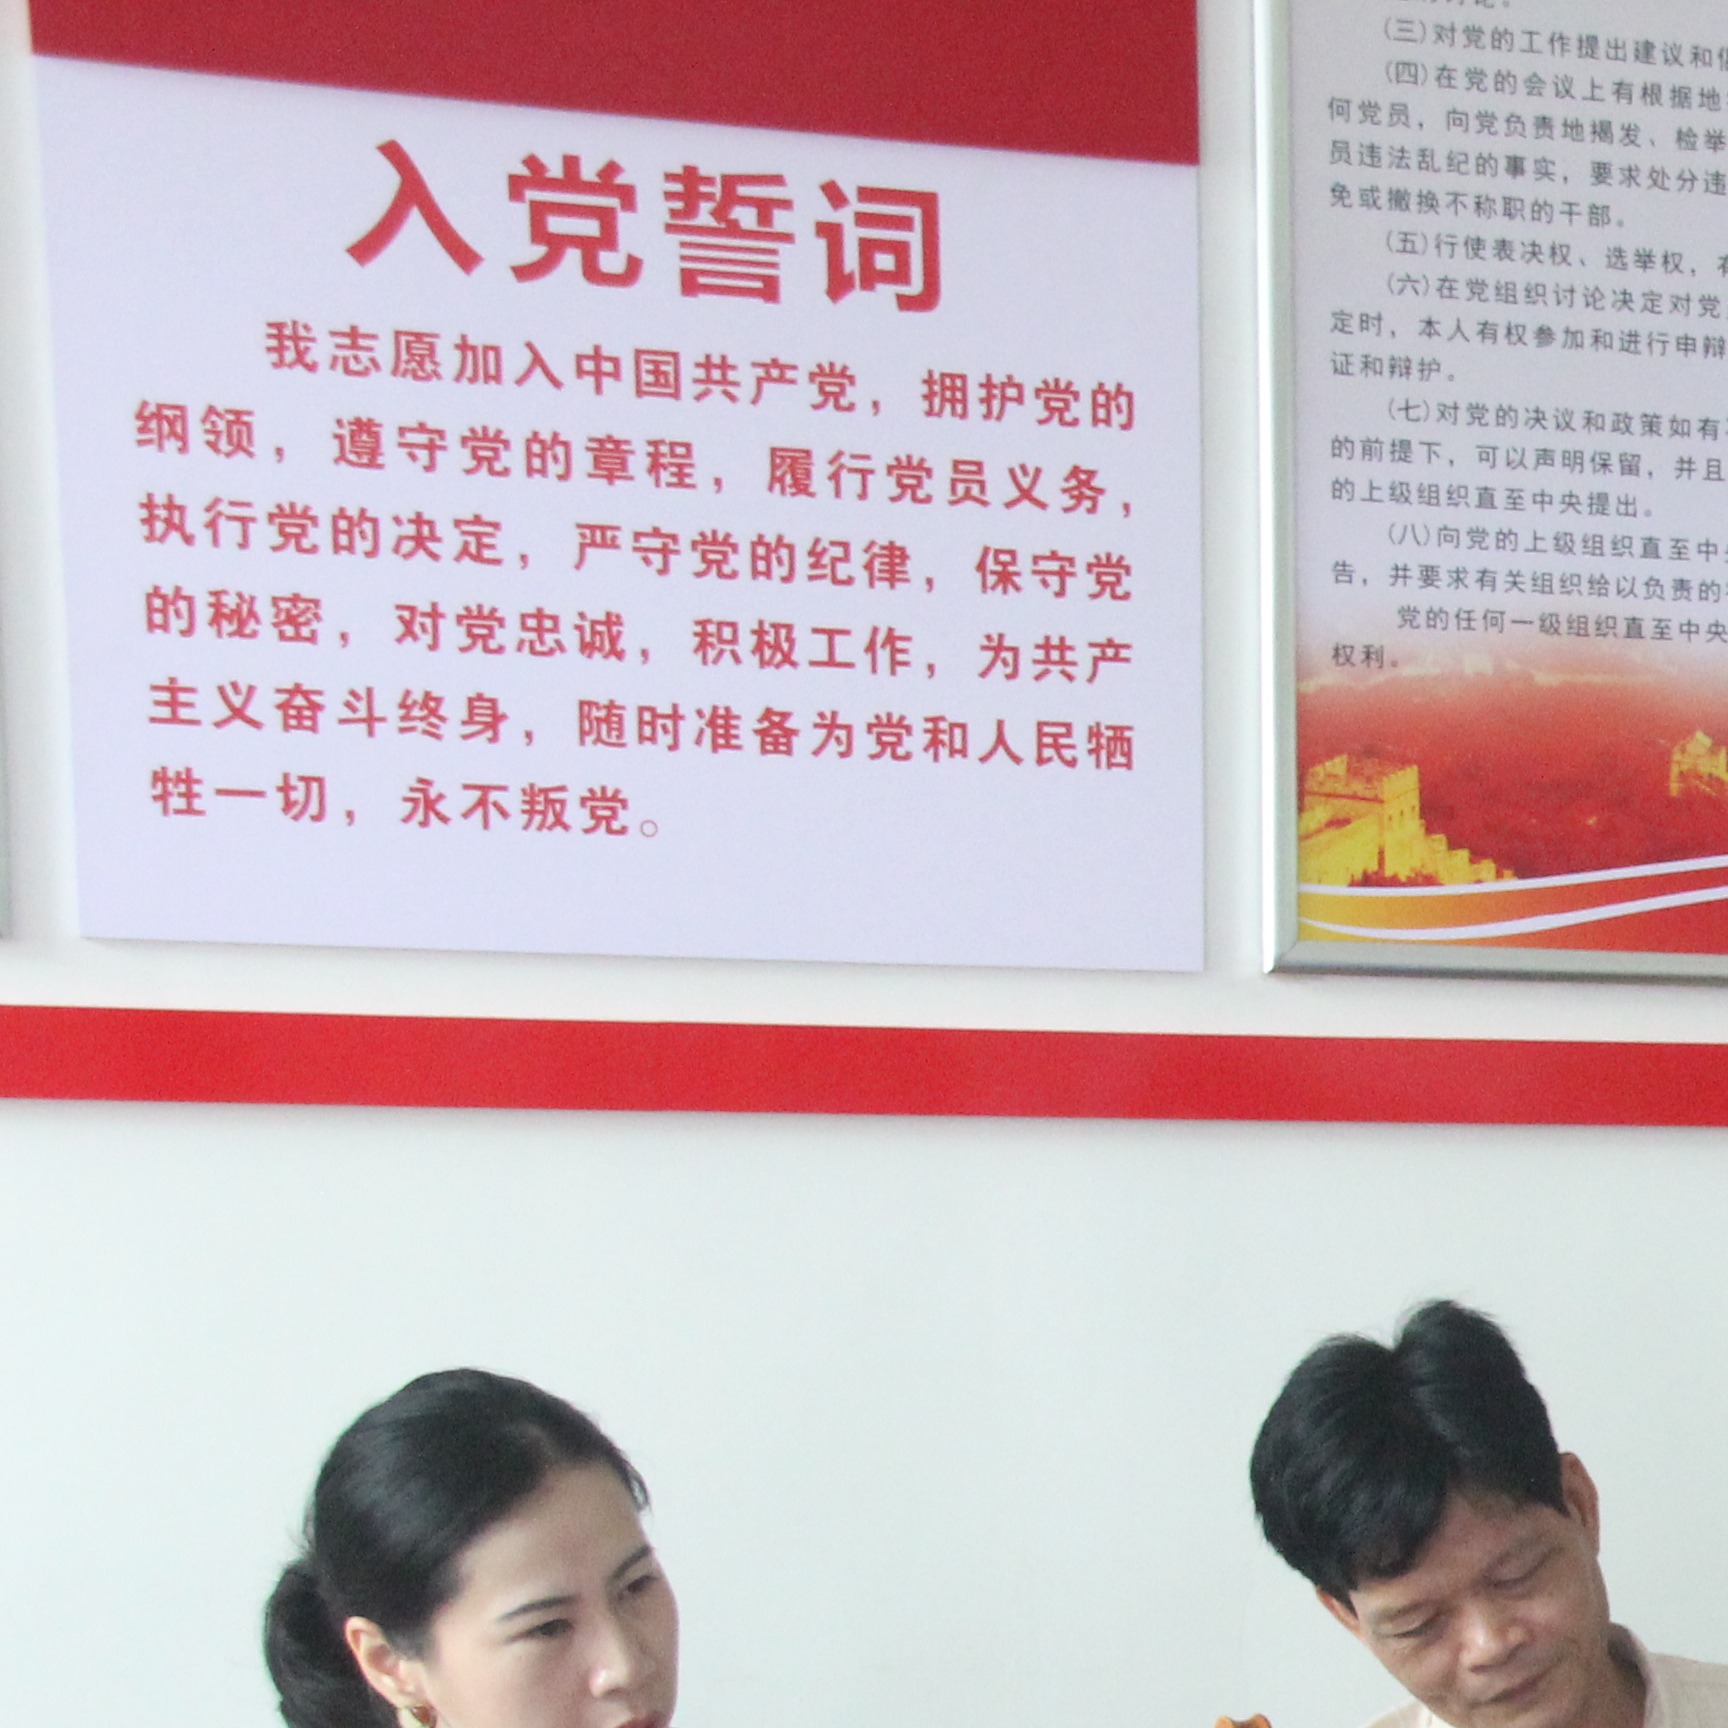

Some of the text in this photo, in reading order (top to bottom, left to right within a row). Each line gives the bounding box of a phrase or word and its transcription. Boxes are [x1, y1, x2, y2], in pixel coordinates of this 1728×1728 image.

[345, 139, 943, 313] 入党誓词
[266, 319, 1137, 433] 我志愿加入中国共产党，拥护党的
[138, 493, 1134, 603] 执行党的决定，严守党的纪律，保守党
[145, 585, 1134, 686] 的秘密，对党忠诚，积极工作，为共产
[148, 677, 1135, 772] 主义奋斗终身，随时准备为党和人民牺
[150, 767, 662, 840] 牲一切，永不叛党。
